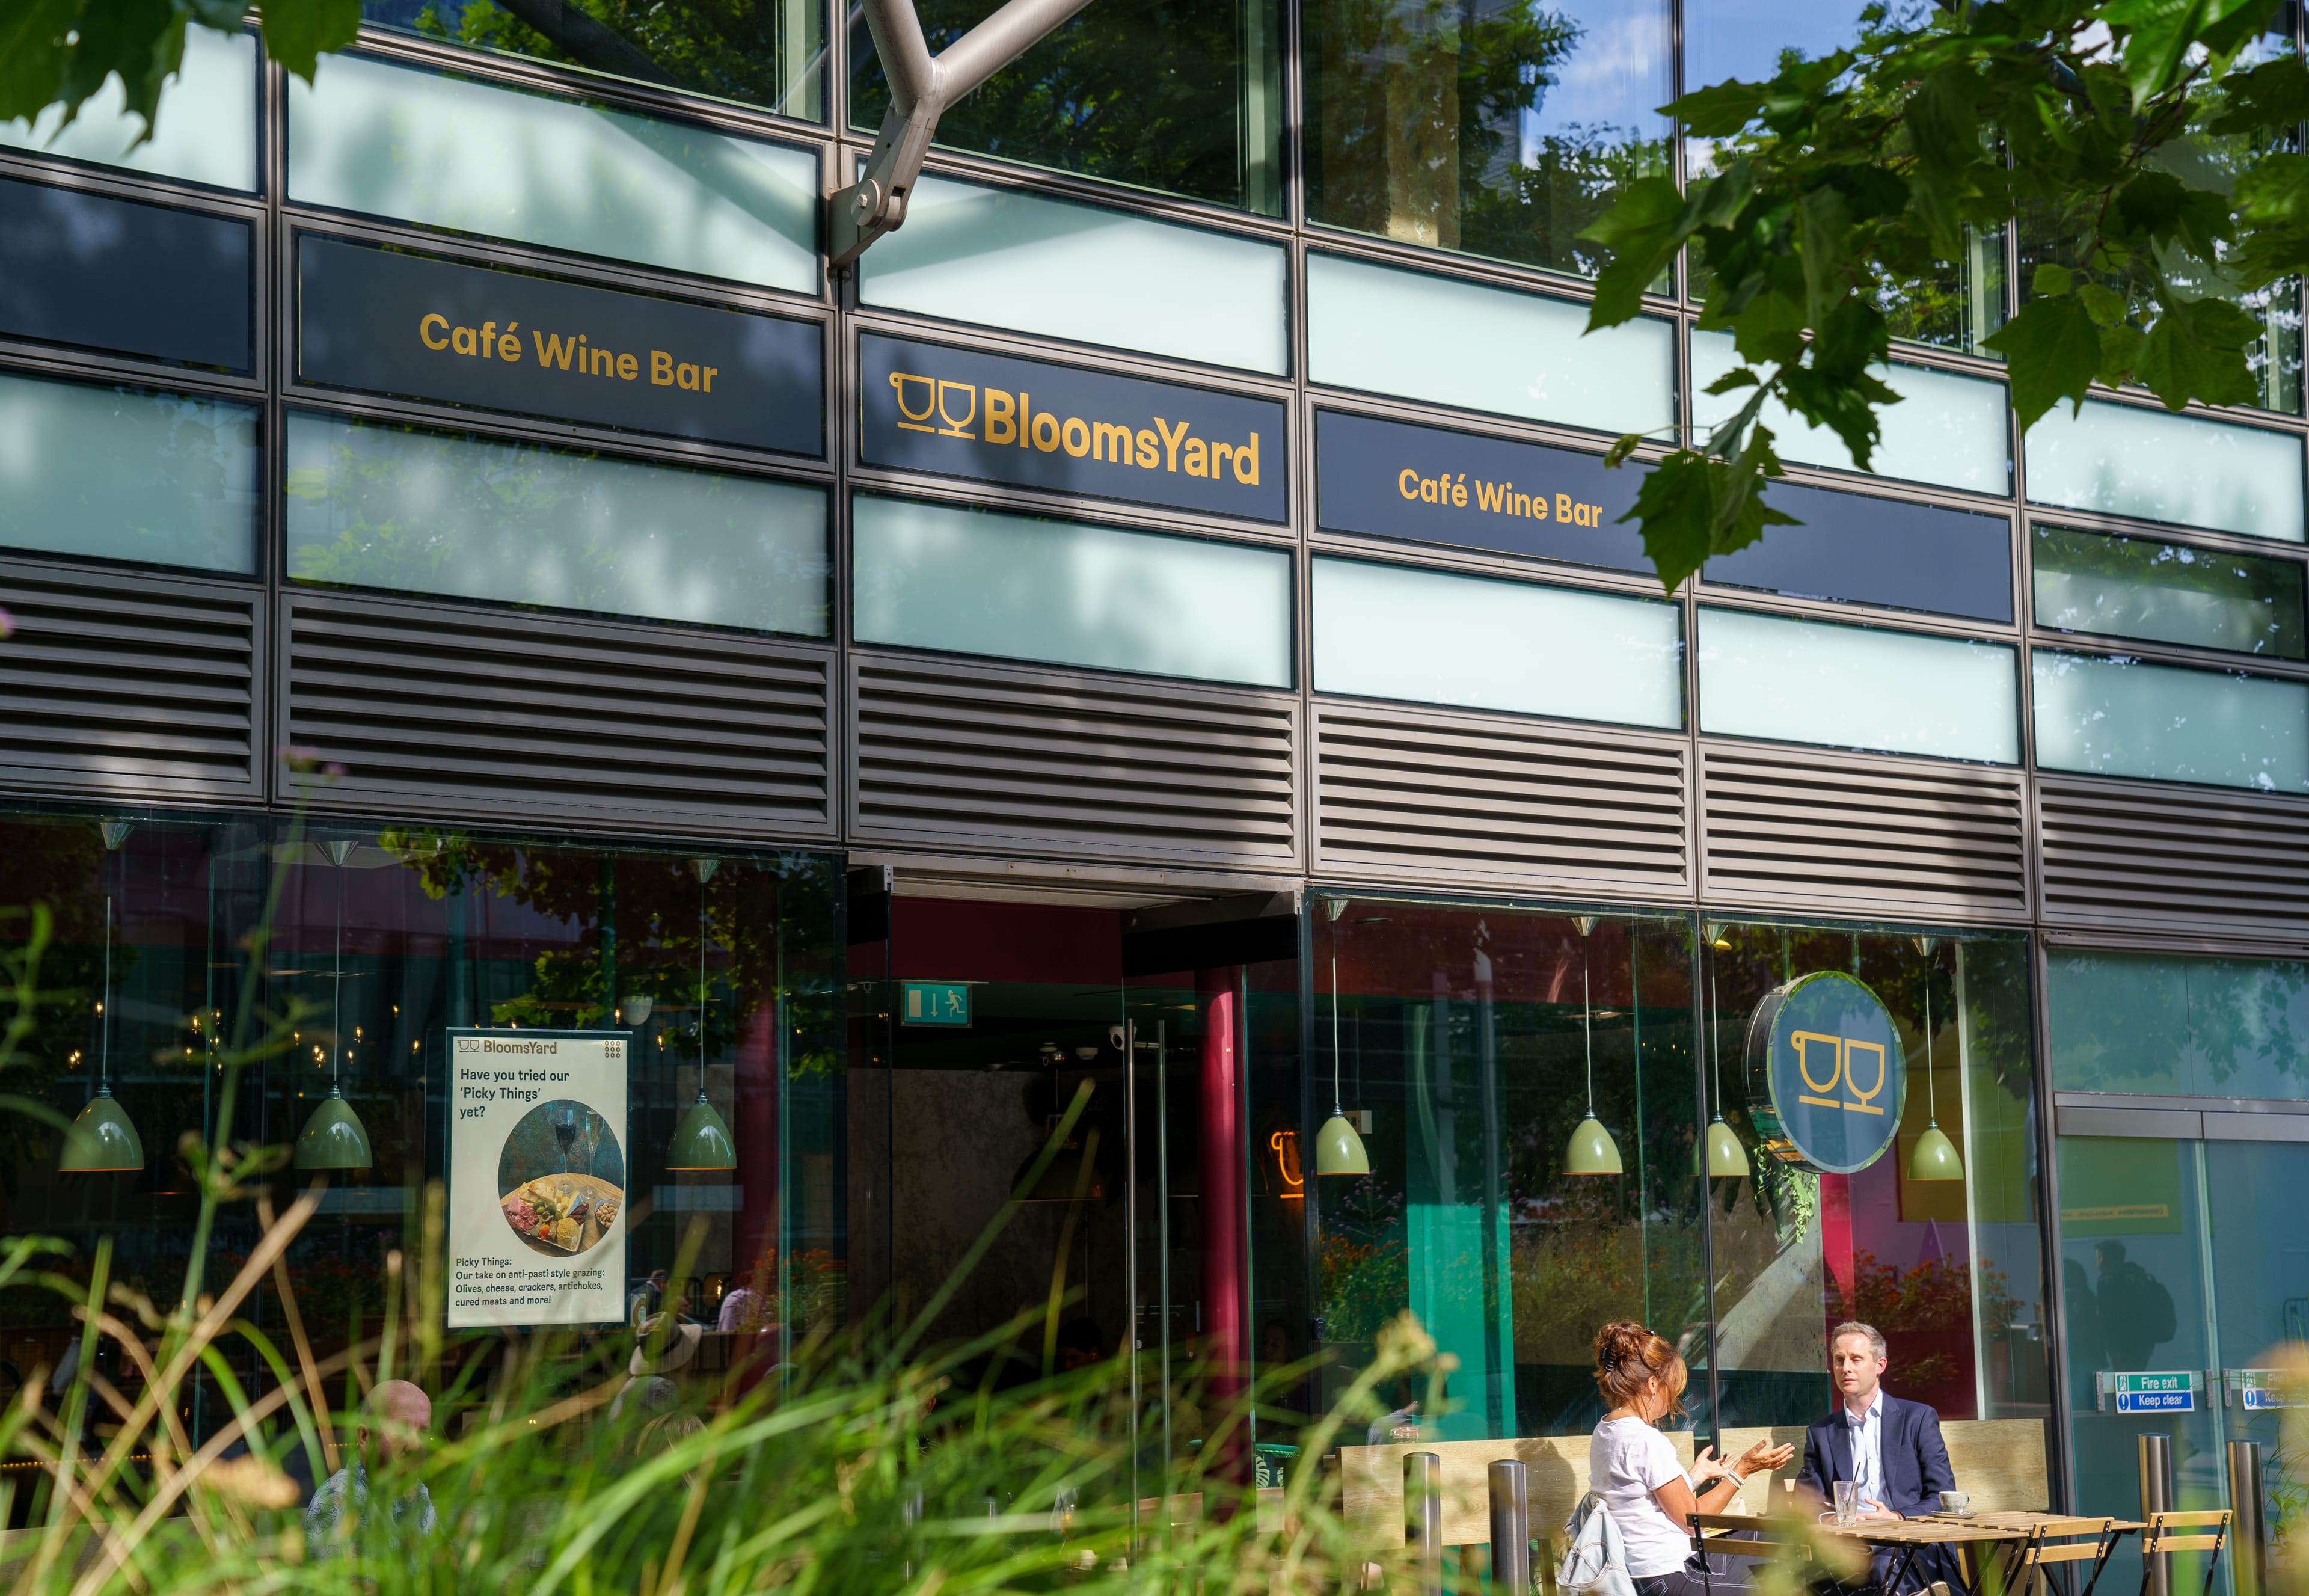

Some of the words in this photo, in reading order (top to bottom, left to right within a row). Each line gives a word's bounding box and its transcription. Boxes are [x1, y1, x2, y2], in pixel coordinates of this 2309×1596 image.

[420, 313, 521, 363] Café
[532, 330, 639, 381] Wine
[651, 349, 718, 393] Bar
[984, 387, 1260, 486] BloomsYard
[1398, 468, 1468, 508] Café
[1474, 480, 1548, 520] Wine
[1556, 493, 1603, 529] Bar
[483, 1040, 557, 1054] BloomsYard
[461, 1068, 490, 1080] Have
[494, 1072, 515, 1083] you
[518, 1069, 546, 1081] tried
[550, 1072, 569, 1081] our
[460, 1087, 496, 1101] 'Picky
[499, 1087, 541, 1102] Things'
[459, 1106, 485, 1120] yet?
[456, 1258, 479, 1268] Picky
[481, 1257, 512, 1268] Things:
[456, 1271, 473, 1280] Our
[475, 1271, 494, 1279] take
[508, 1269, 548, 1280] anti-pasti
[551, 1269, 571, 1278] style
[572, 1268, 605, 1279] grazing:
[456, 1284, 483, 1294] Olives,
[485, 1283, 516, 1293] cheese,
[518, 1282, 556, 1292] crackers,
[558, 1281, 603, 1291] artichokes,
[455, 1298, 480, 1306] cured
[482, 1297, 507, 1306] meats
[509, 1296, 525, 1305] and
[527, 1295, 551, 1304] more!
[2141, 1377, 2160, 1389] Fire
[2162, 1376, 2178, 1389] exit
[2139, 1395, 2161, 1408] Keep
[2163, 1394, 2183, 1405] clear
